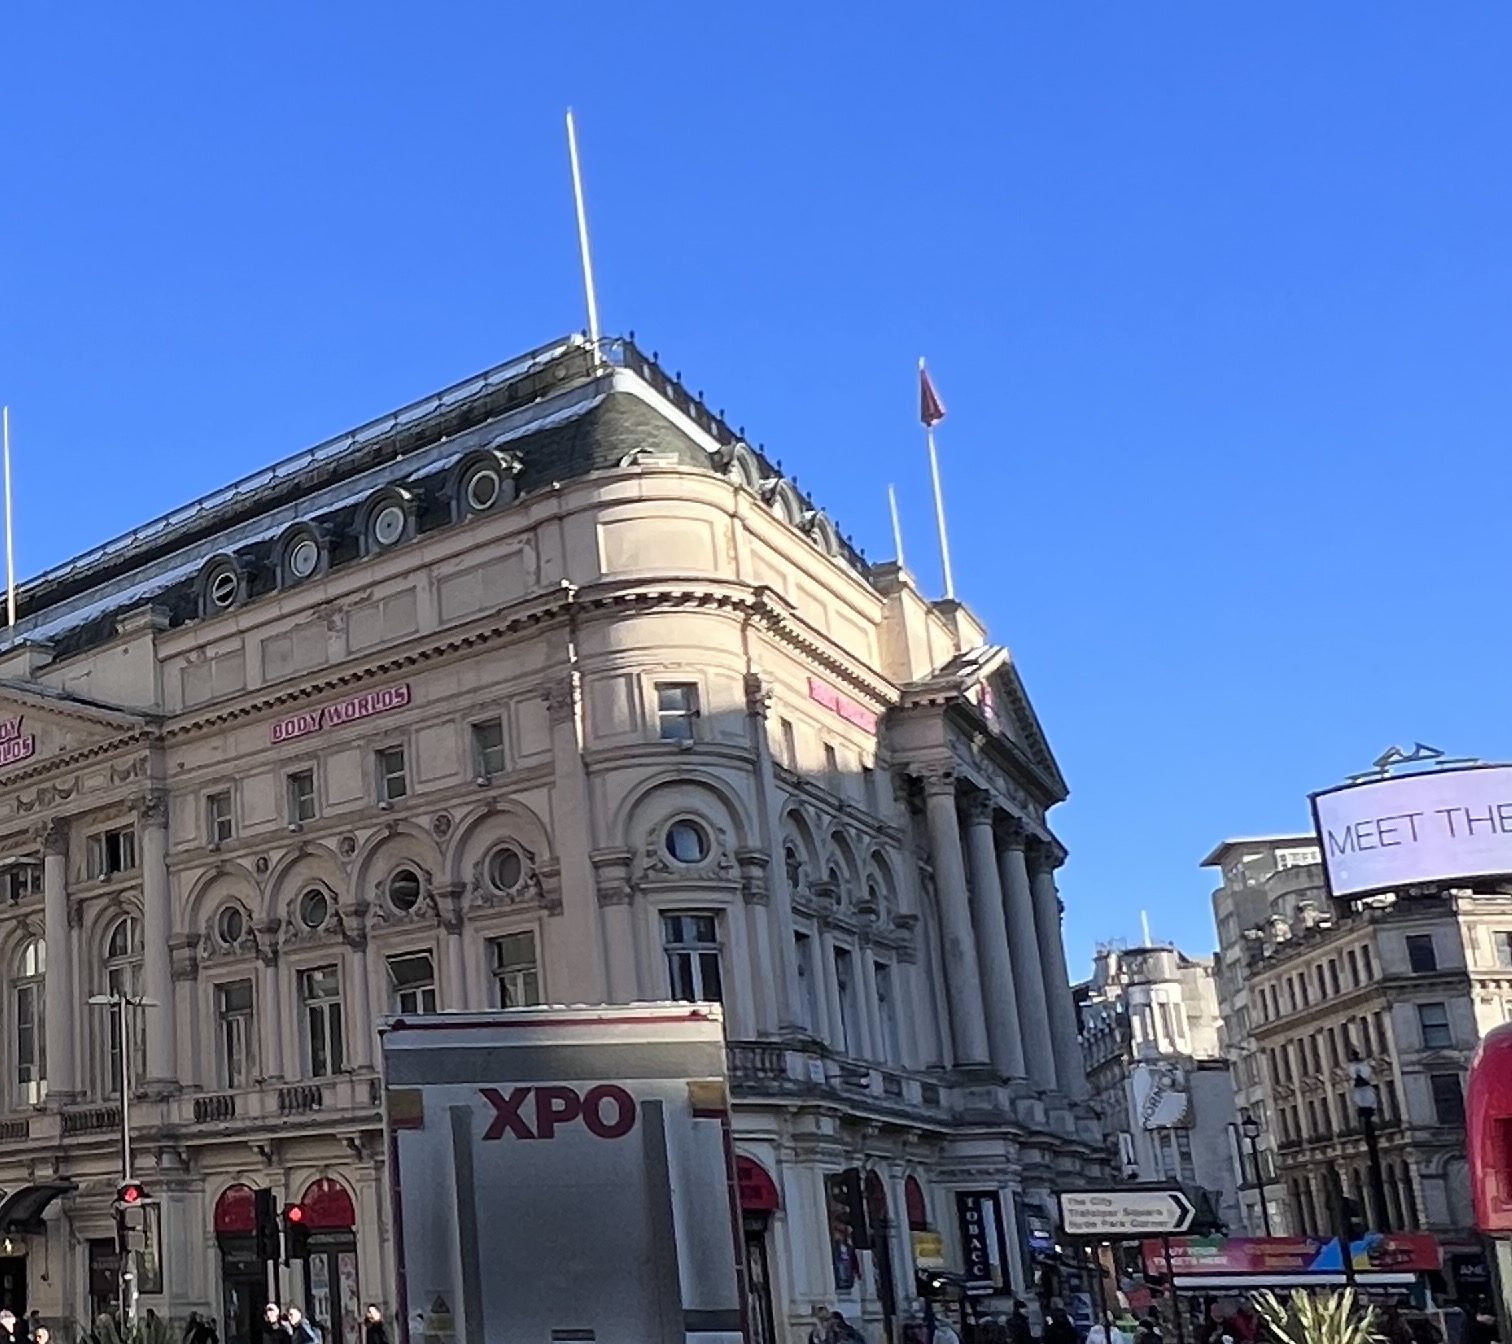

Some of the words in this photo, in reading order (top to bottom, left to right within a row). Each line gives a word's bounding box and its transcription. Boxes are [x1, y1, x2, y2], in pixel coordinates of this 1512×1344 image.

[271, 707, 325, 744] BODY
[326, 683, 411, 727] WORLDS
[1328, 811, 1424, 858] MEET
[1435, 803, 1512, 838] THE
[478, 1084, 637, 1141] XPO
